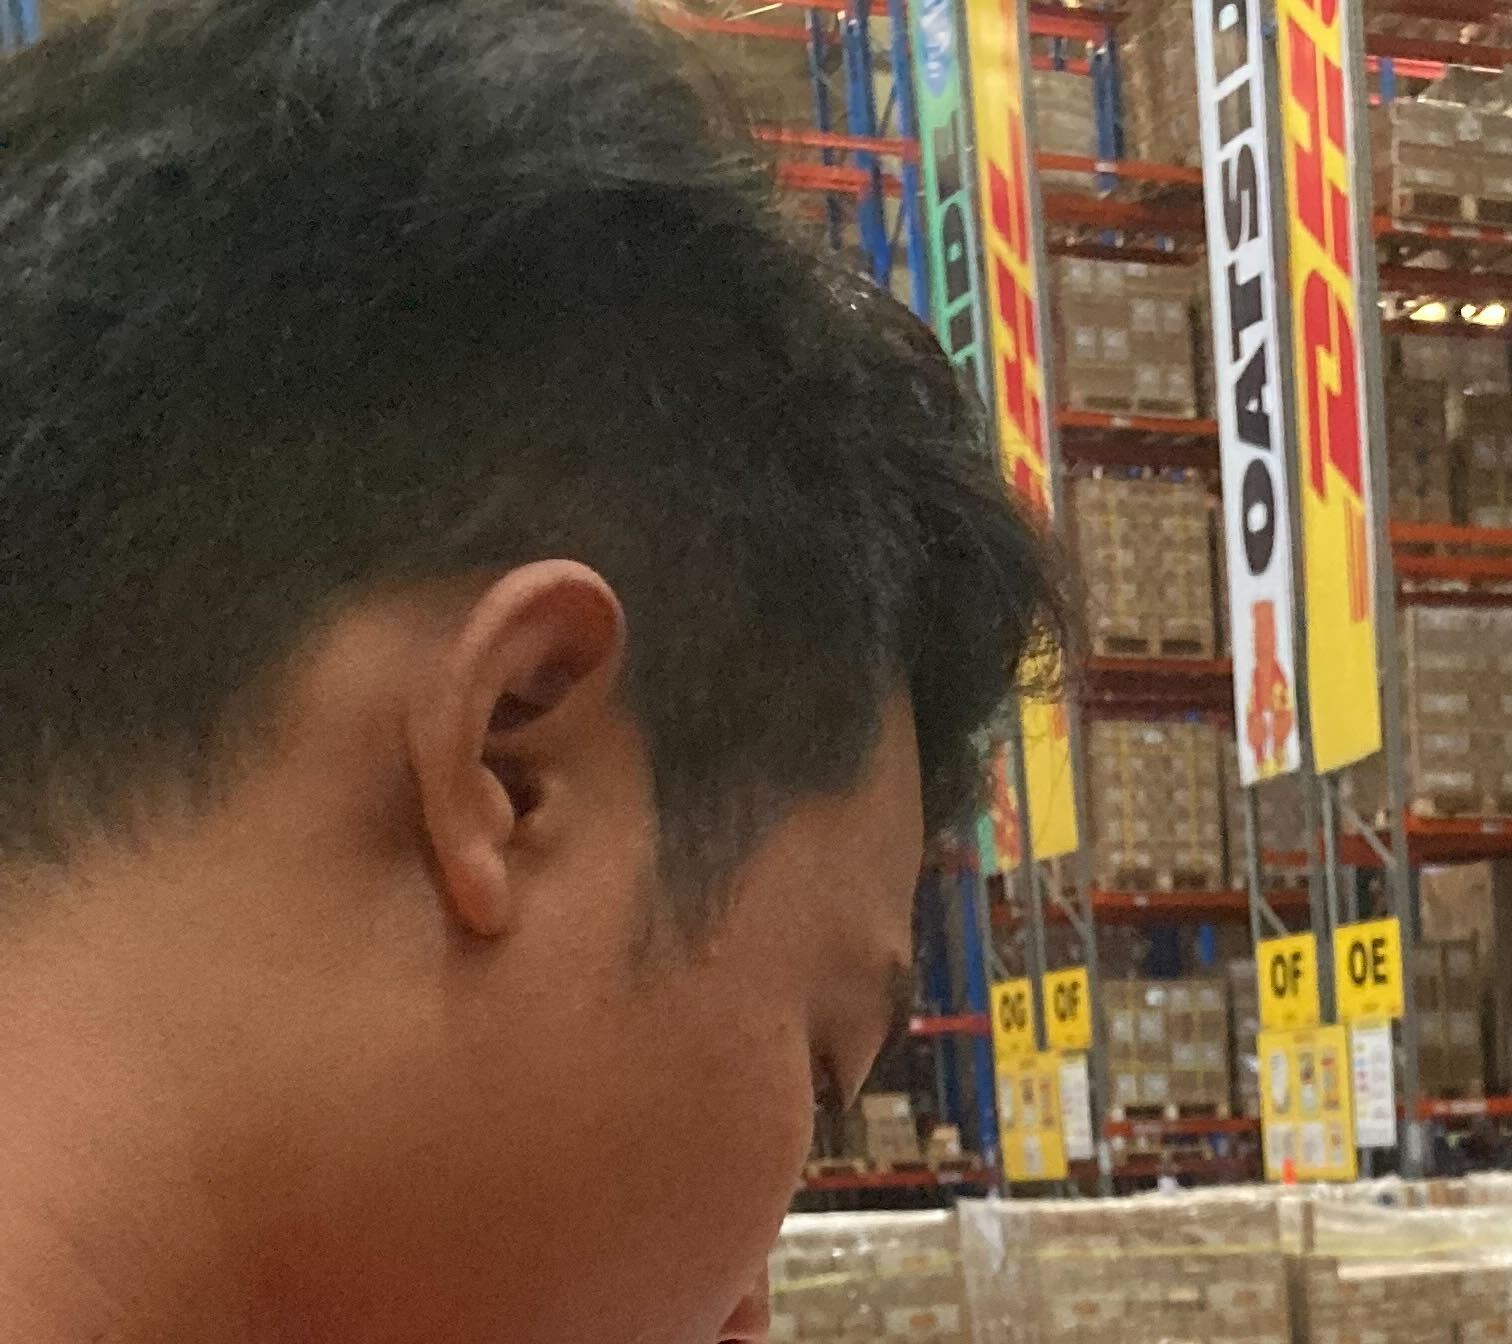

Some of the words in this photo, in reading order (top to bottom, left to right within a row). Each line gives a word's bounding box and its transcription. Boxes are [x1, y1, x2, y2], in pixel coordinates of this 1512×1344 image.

[1285, 0, 1364, 502] DH
[1269, 951, 1303, 999] OF
[1347, 937, 1389, 987] OE
